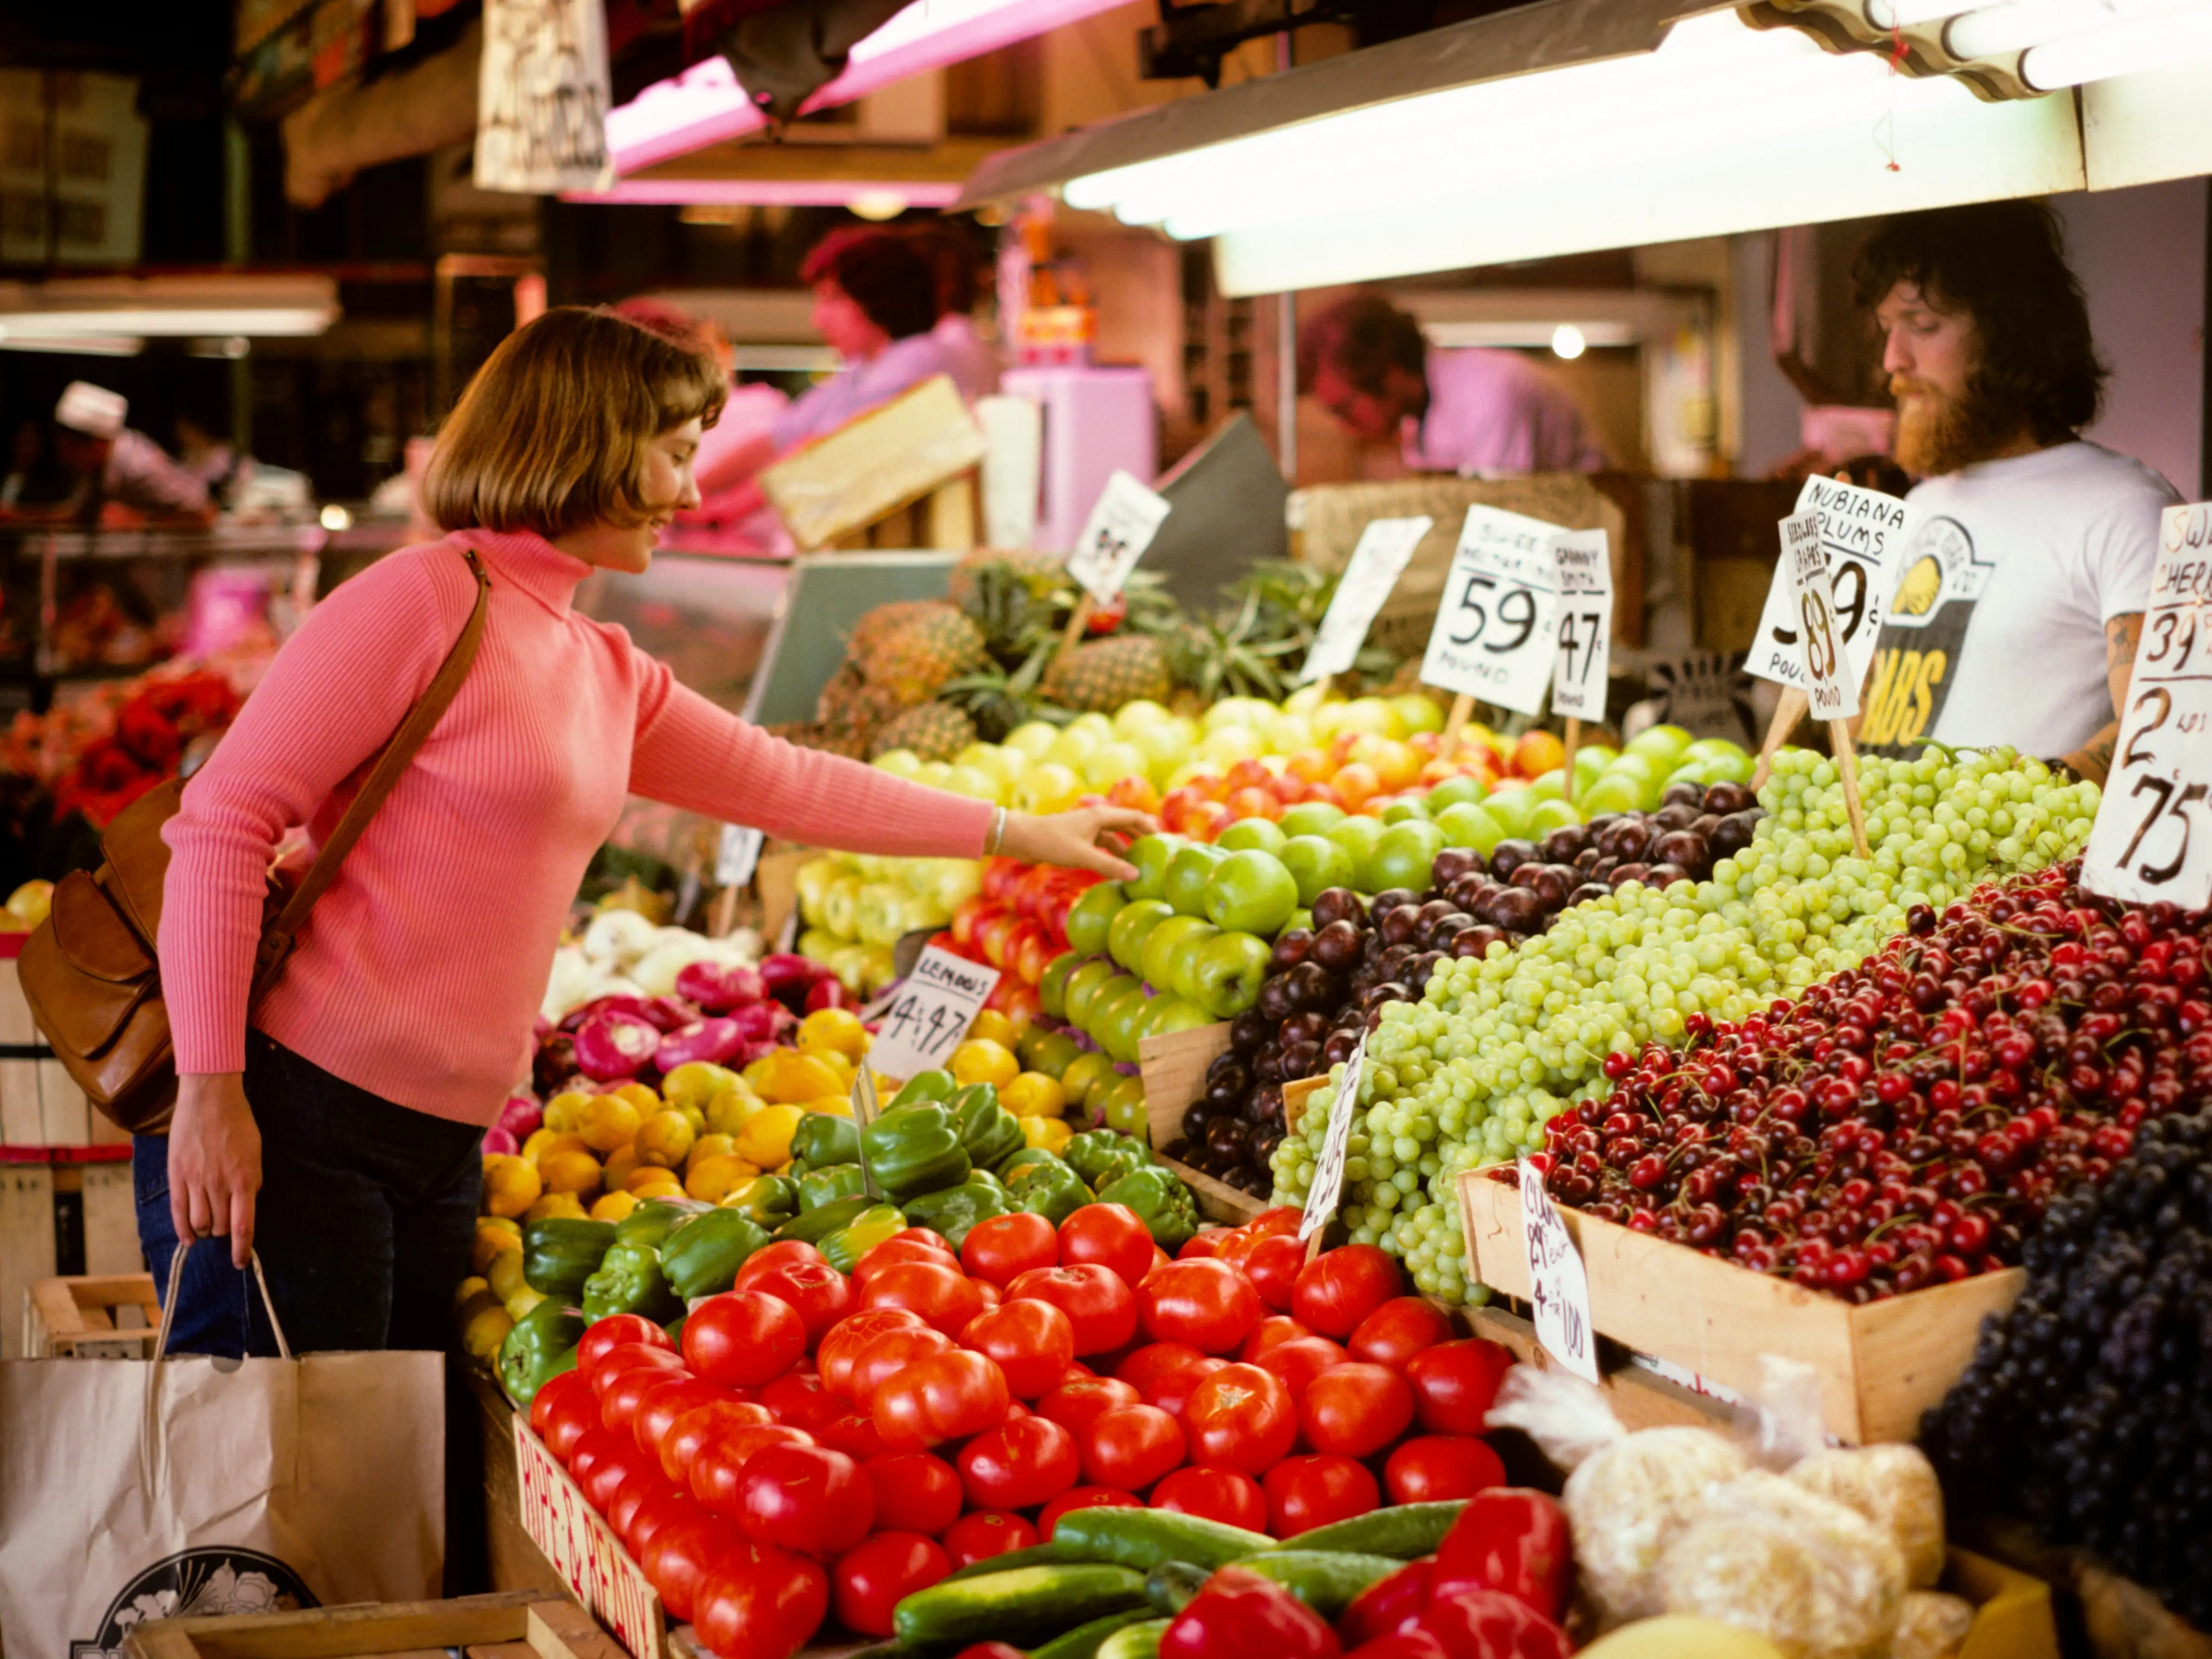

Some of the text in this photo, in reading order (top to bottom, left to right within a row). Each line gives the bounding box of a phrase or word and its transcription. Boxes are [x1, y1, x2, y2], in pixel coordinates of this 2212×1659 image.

[1808, 482, 1904, 530] NUBIANA
[1818, 512, 1884, 556] PLUMS
[919, 957, 989, 996] LEMONS
